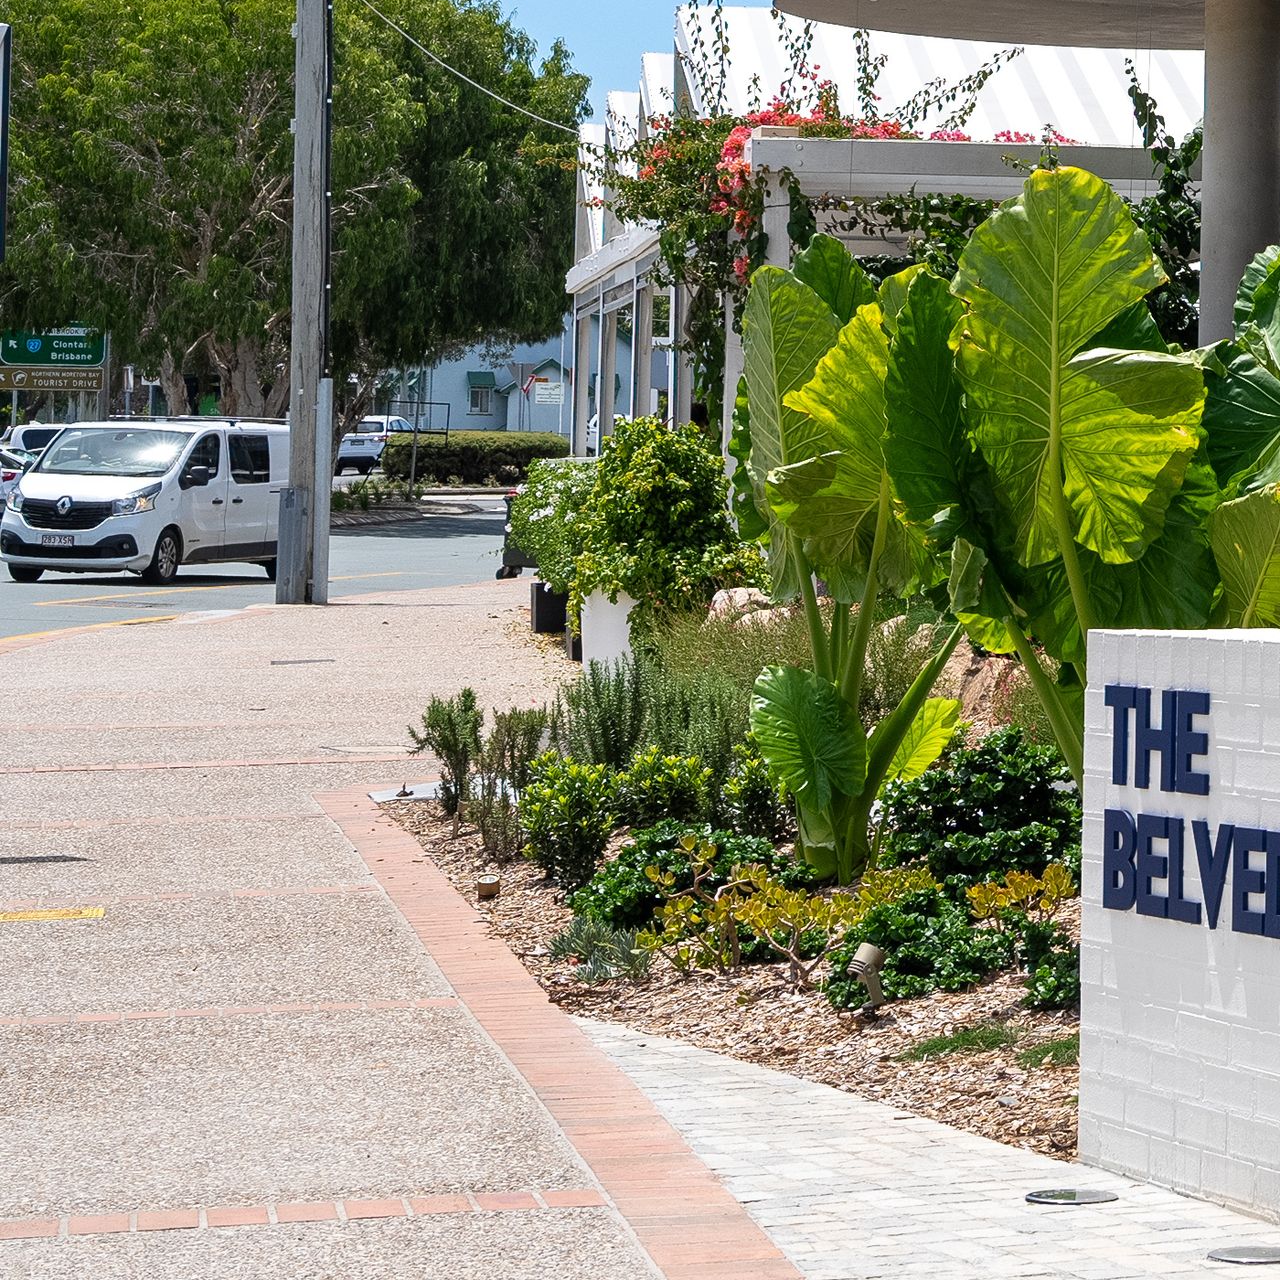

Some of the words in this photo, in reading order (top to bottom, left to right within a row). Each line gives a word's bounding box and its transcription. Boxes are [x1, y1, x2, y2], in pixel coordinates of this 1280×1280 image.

[29, 341, 39, 350] 27
[50, 352, 93, 360] Brisbane
[33, 379, 68, 387] TOURIST
[72, 380, 98, 388] DRIVE
[1104, 683, 1211, 796] THE
